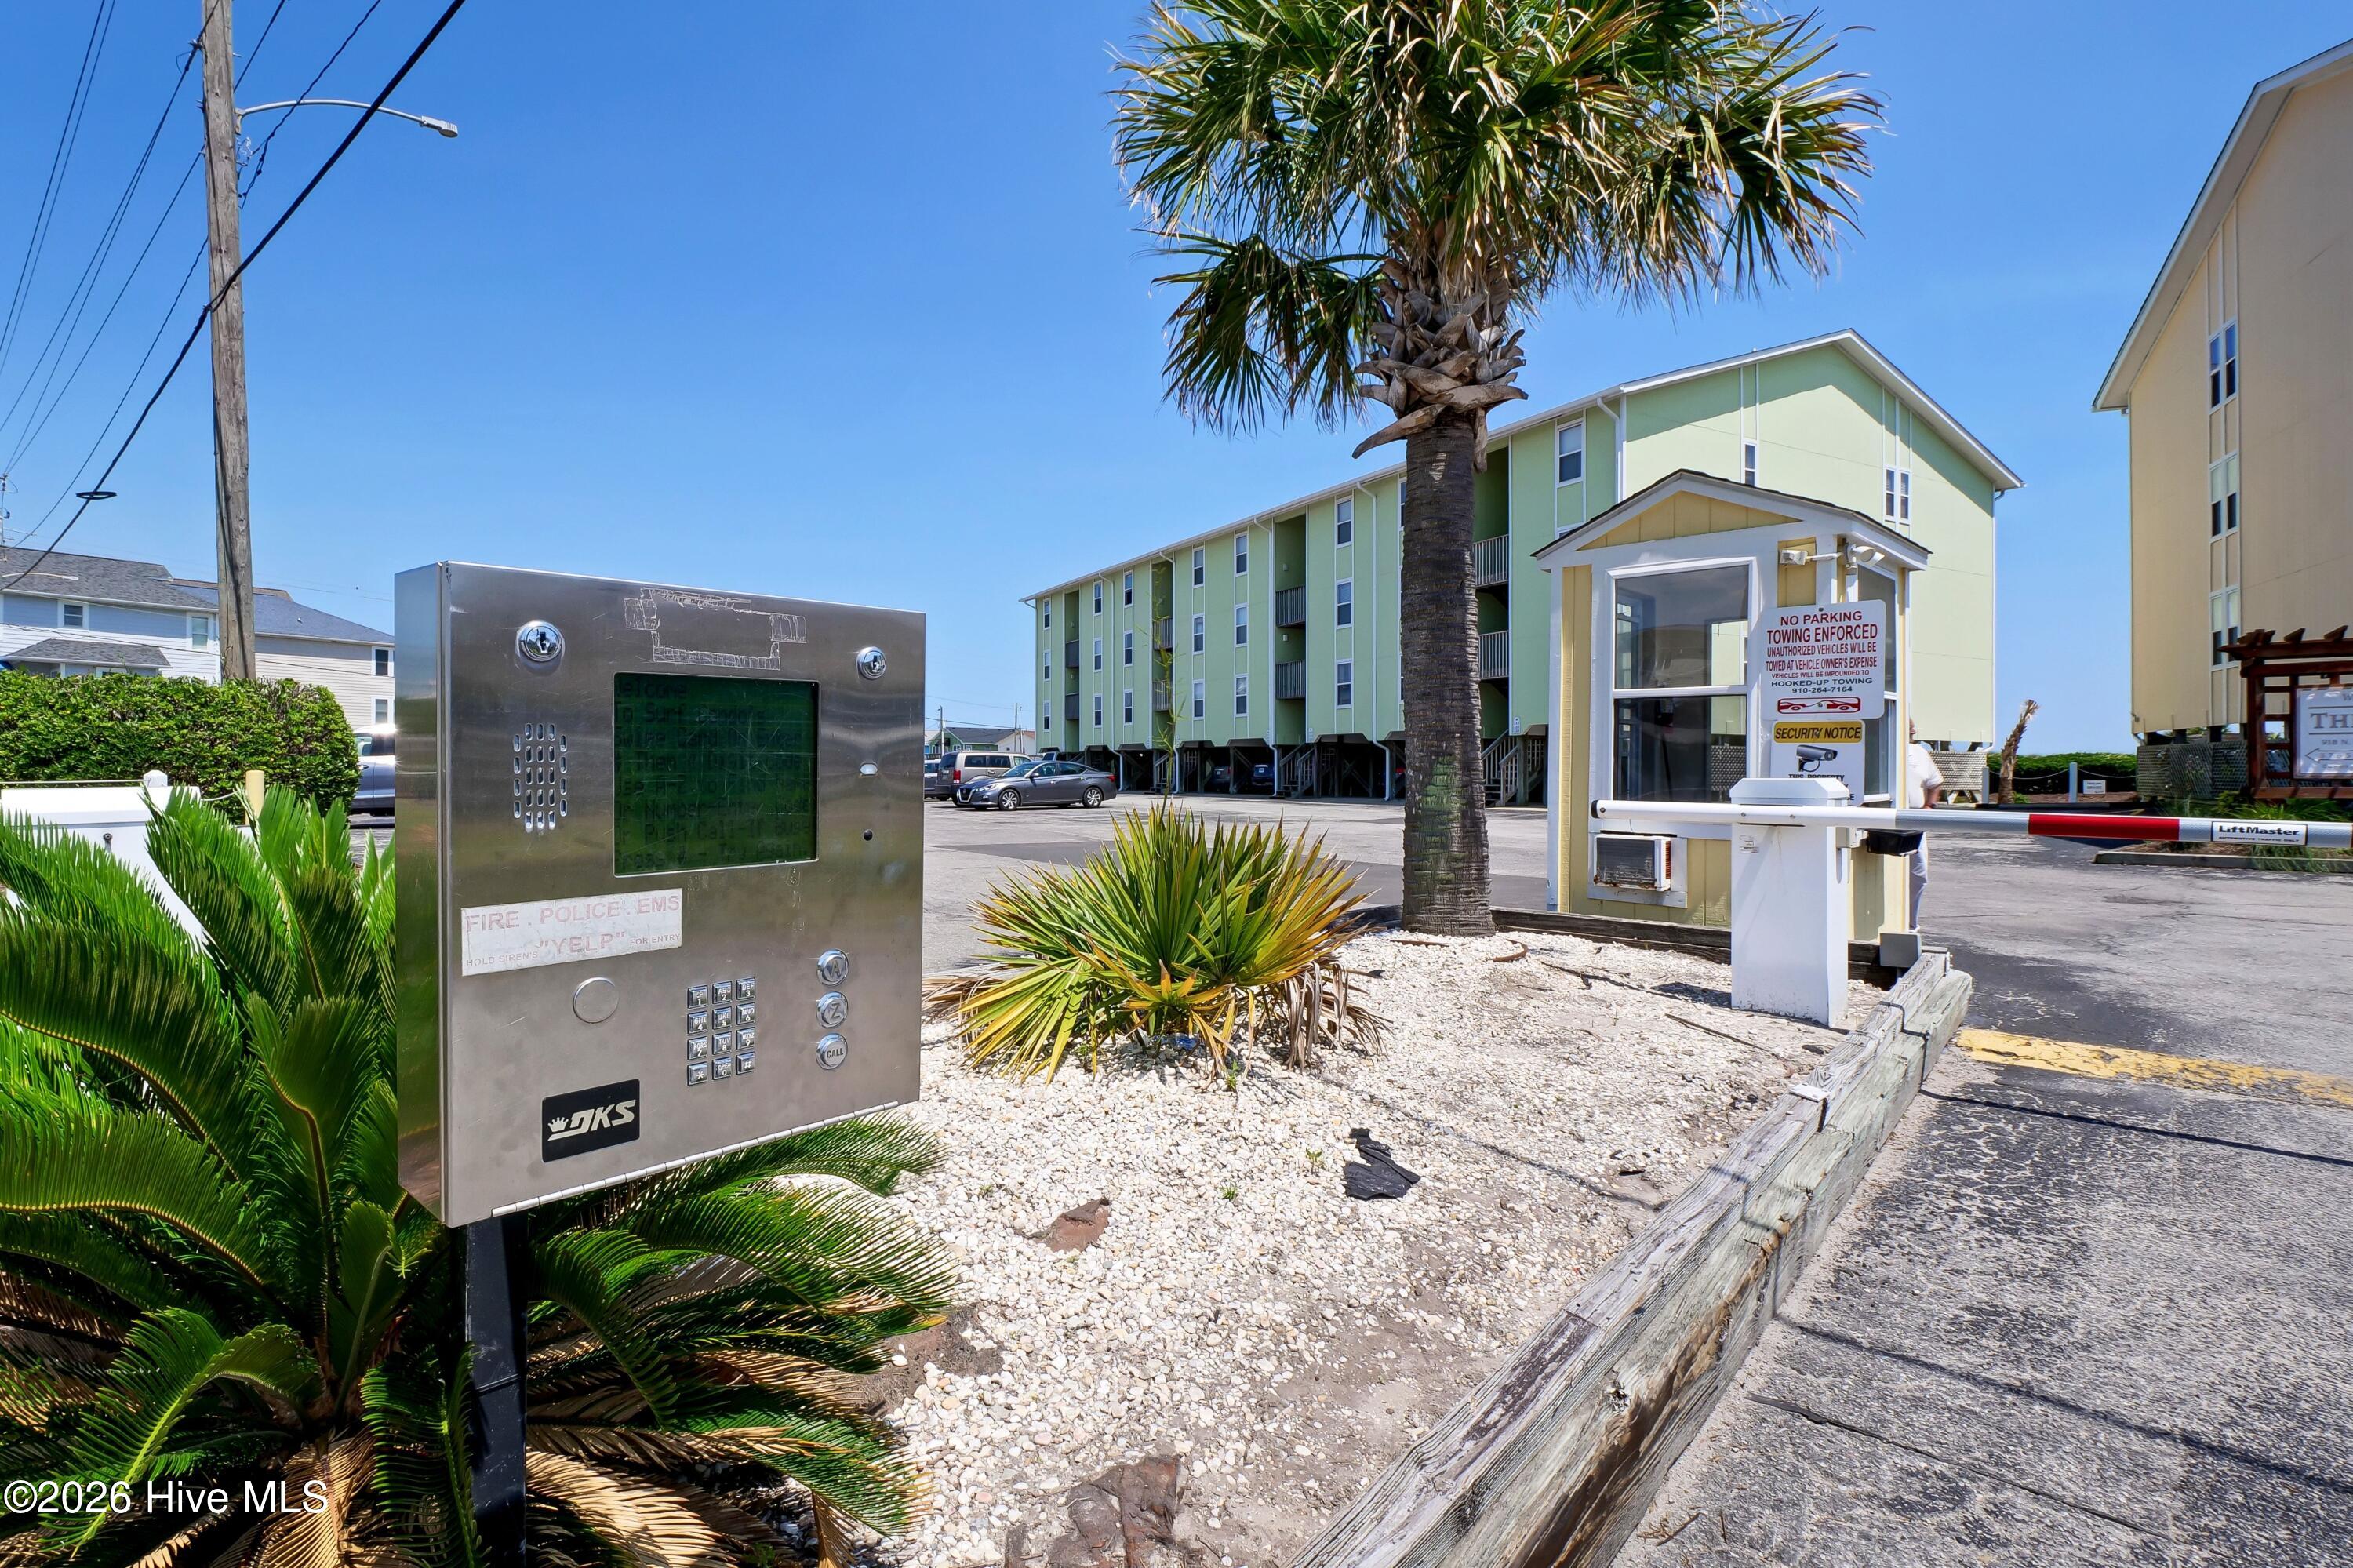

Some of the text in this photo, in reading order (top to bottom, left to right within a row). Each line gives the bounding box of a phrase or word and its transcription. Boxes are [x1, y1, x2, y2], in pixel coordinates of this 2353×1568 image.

[1780, 611, 1862, 626] NO PARKING
[1767, 624, 1878, 644] TOWING ENFORCED
[1767, 642, 1876, 657] UNAUTHORIZED VEHICLES WILL BE
[1766, 656, 1877, 671] TOWED AT VEHICLE OWNER'S EXPENSE
[1775, 727, 1861, 739] SECURITY NOTICE
[2218, 825, 2300, 835] LiftMaster
[465, 895, 680, 933] FIRE POLICE EMS
[499, 951, 539, 963] SIREN'S
[630, 937, 649, 946] FOR
[652, 933, 681, 944] ENTRY
[831, 960, 841, 977] A
[831, 1002, 841, 1019] Z
[827, 1048, 844, 1059] CALL
[548, 1100, 636, 1141] DKS
